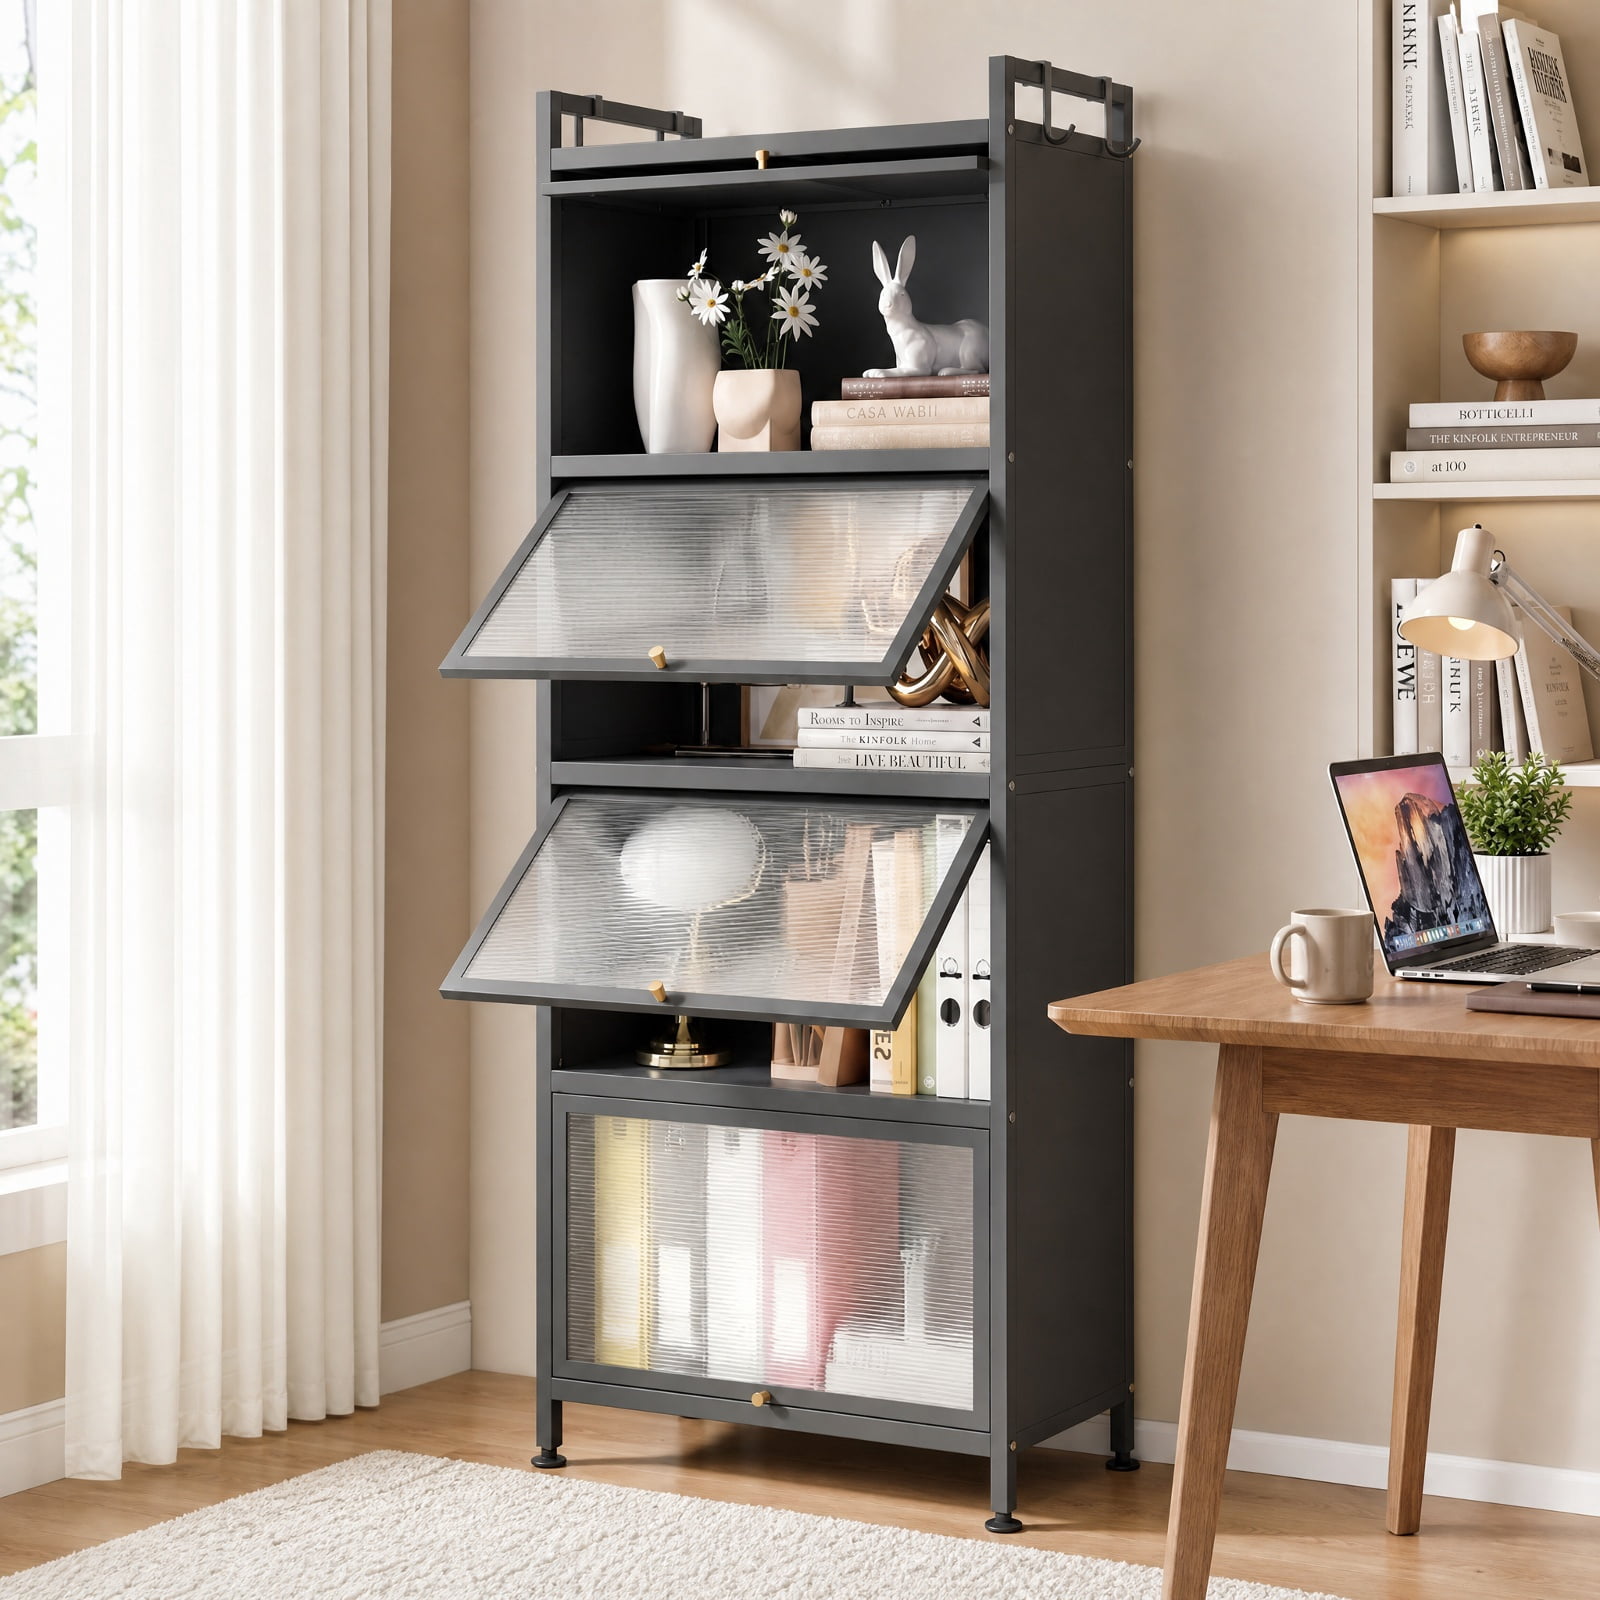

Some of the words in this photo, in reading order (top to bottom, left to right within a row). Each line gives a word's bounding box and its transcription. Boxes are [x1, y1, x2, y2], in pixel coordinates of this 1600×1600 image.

[846, 407, 887, 419] CASA
[1459, 408, 1533, 420] BOTTICELLI
[1430, 434, 1450, 444] THE
[1453, 433, 1498, 443] KINFOLK
[1500, 431, 1578, 442] ENTREPRENEUR
[1431, 463, 1442, 472] at
[1446, 461, 1467, 472] 100
[841, 735, 857, 744] The
[859, 735, 907, 745] KINFOLK
[911, 736, 937, 745] Home
[856, 754, 886, 767] LIVE
[890, 754, 966, 769] BEAUTIFUL
